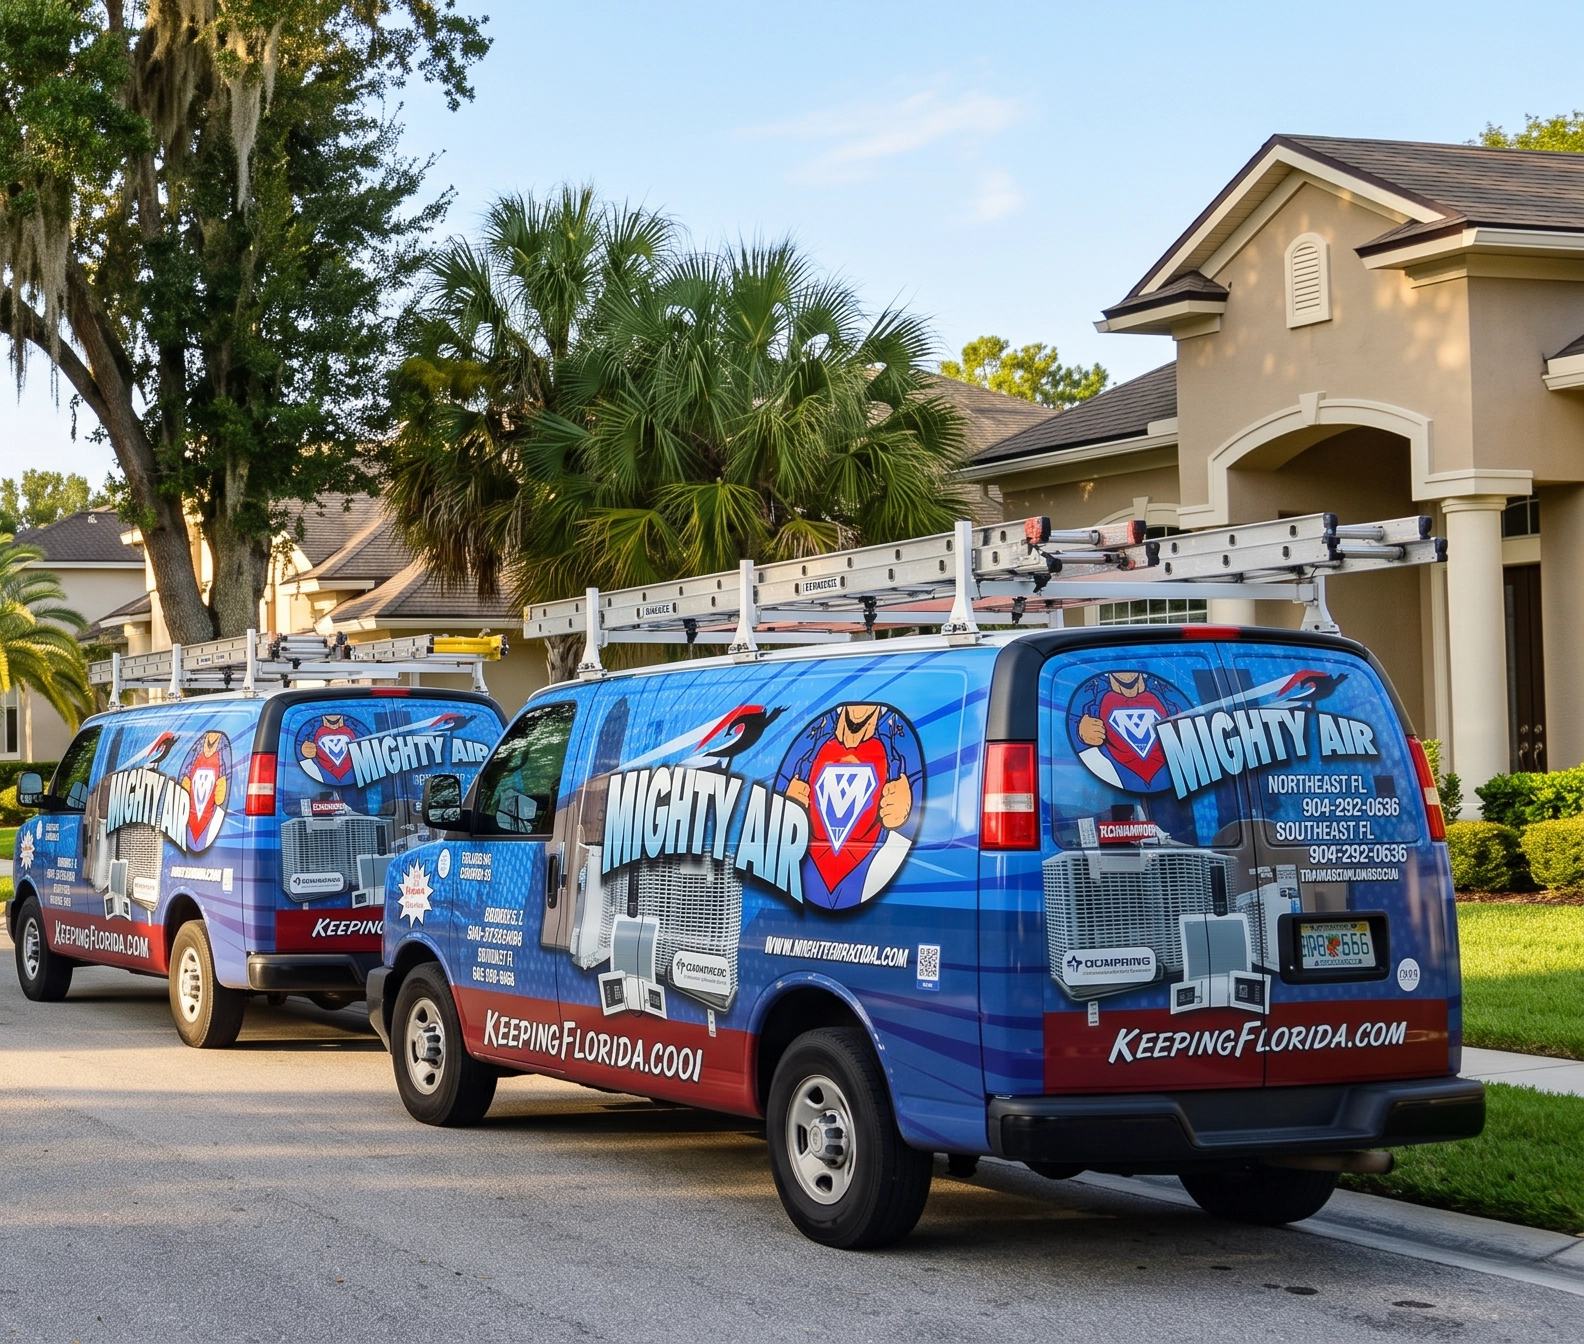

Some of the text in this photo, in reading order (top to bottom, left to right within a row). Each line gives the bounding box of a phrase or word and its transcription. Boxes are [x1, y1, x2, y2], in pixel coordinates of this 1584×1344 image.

[348, 735, 444, 788] MIGHTY
[1157, 708, 1379, 800] MIGHTY AIR
[1268, 775, 1367, 794] NORTHEAST FL
[106, 768, 190, 851] MIGHTY AIR
[1302, 798, 1400, 817] 904-292-0636
[602, 767, 810, 905] MIGHTY AIR
[1276, 821, 1374, 841] SOUTHEAST FL
[1309, 844, 1407, 863] 904-292-0636
[1341, 933, 1370, 957] 666
